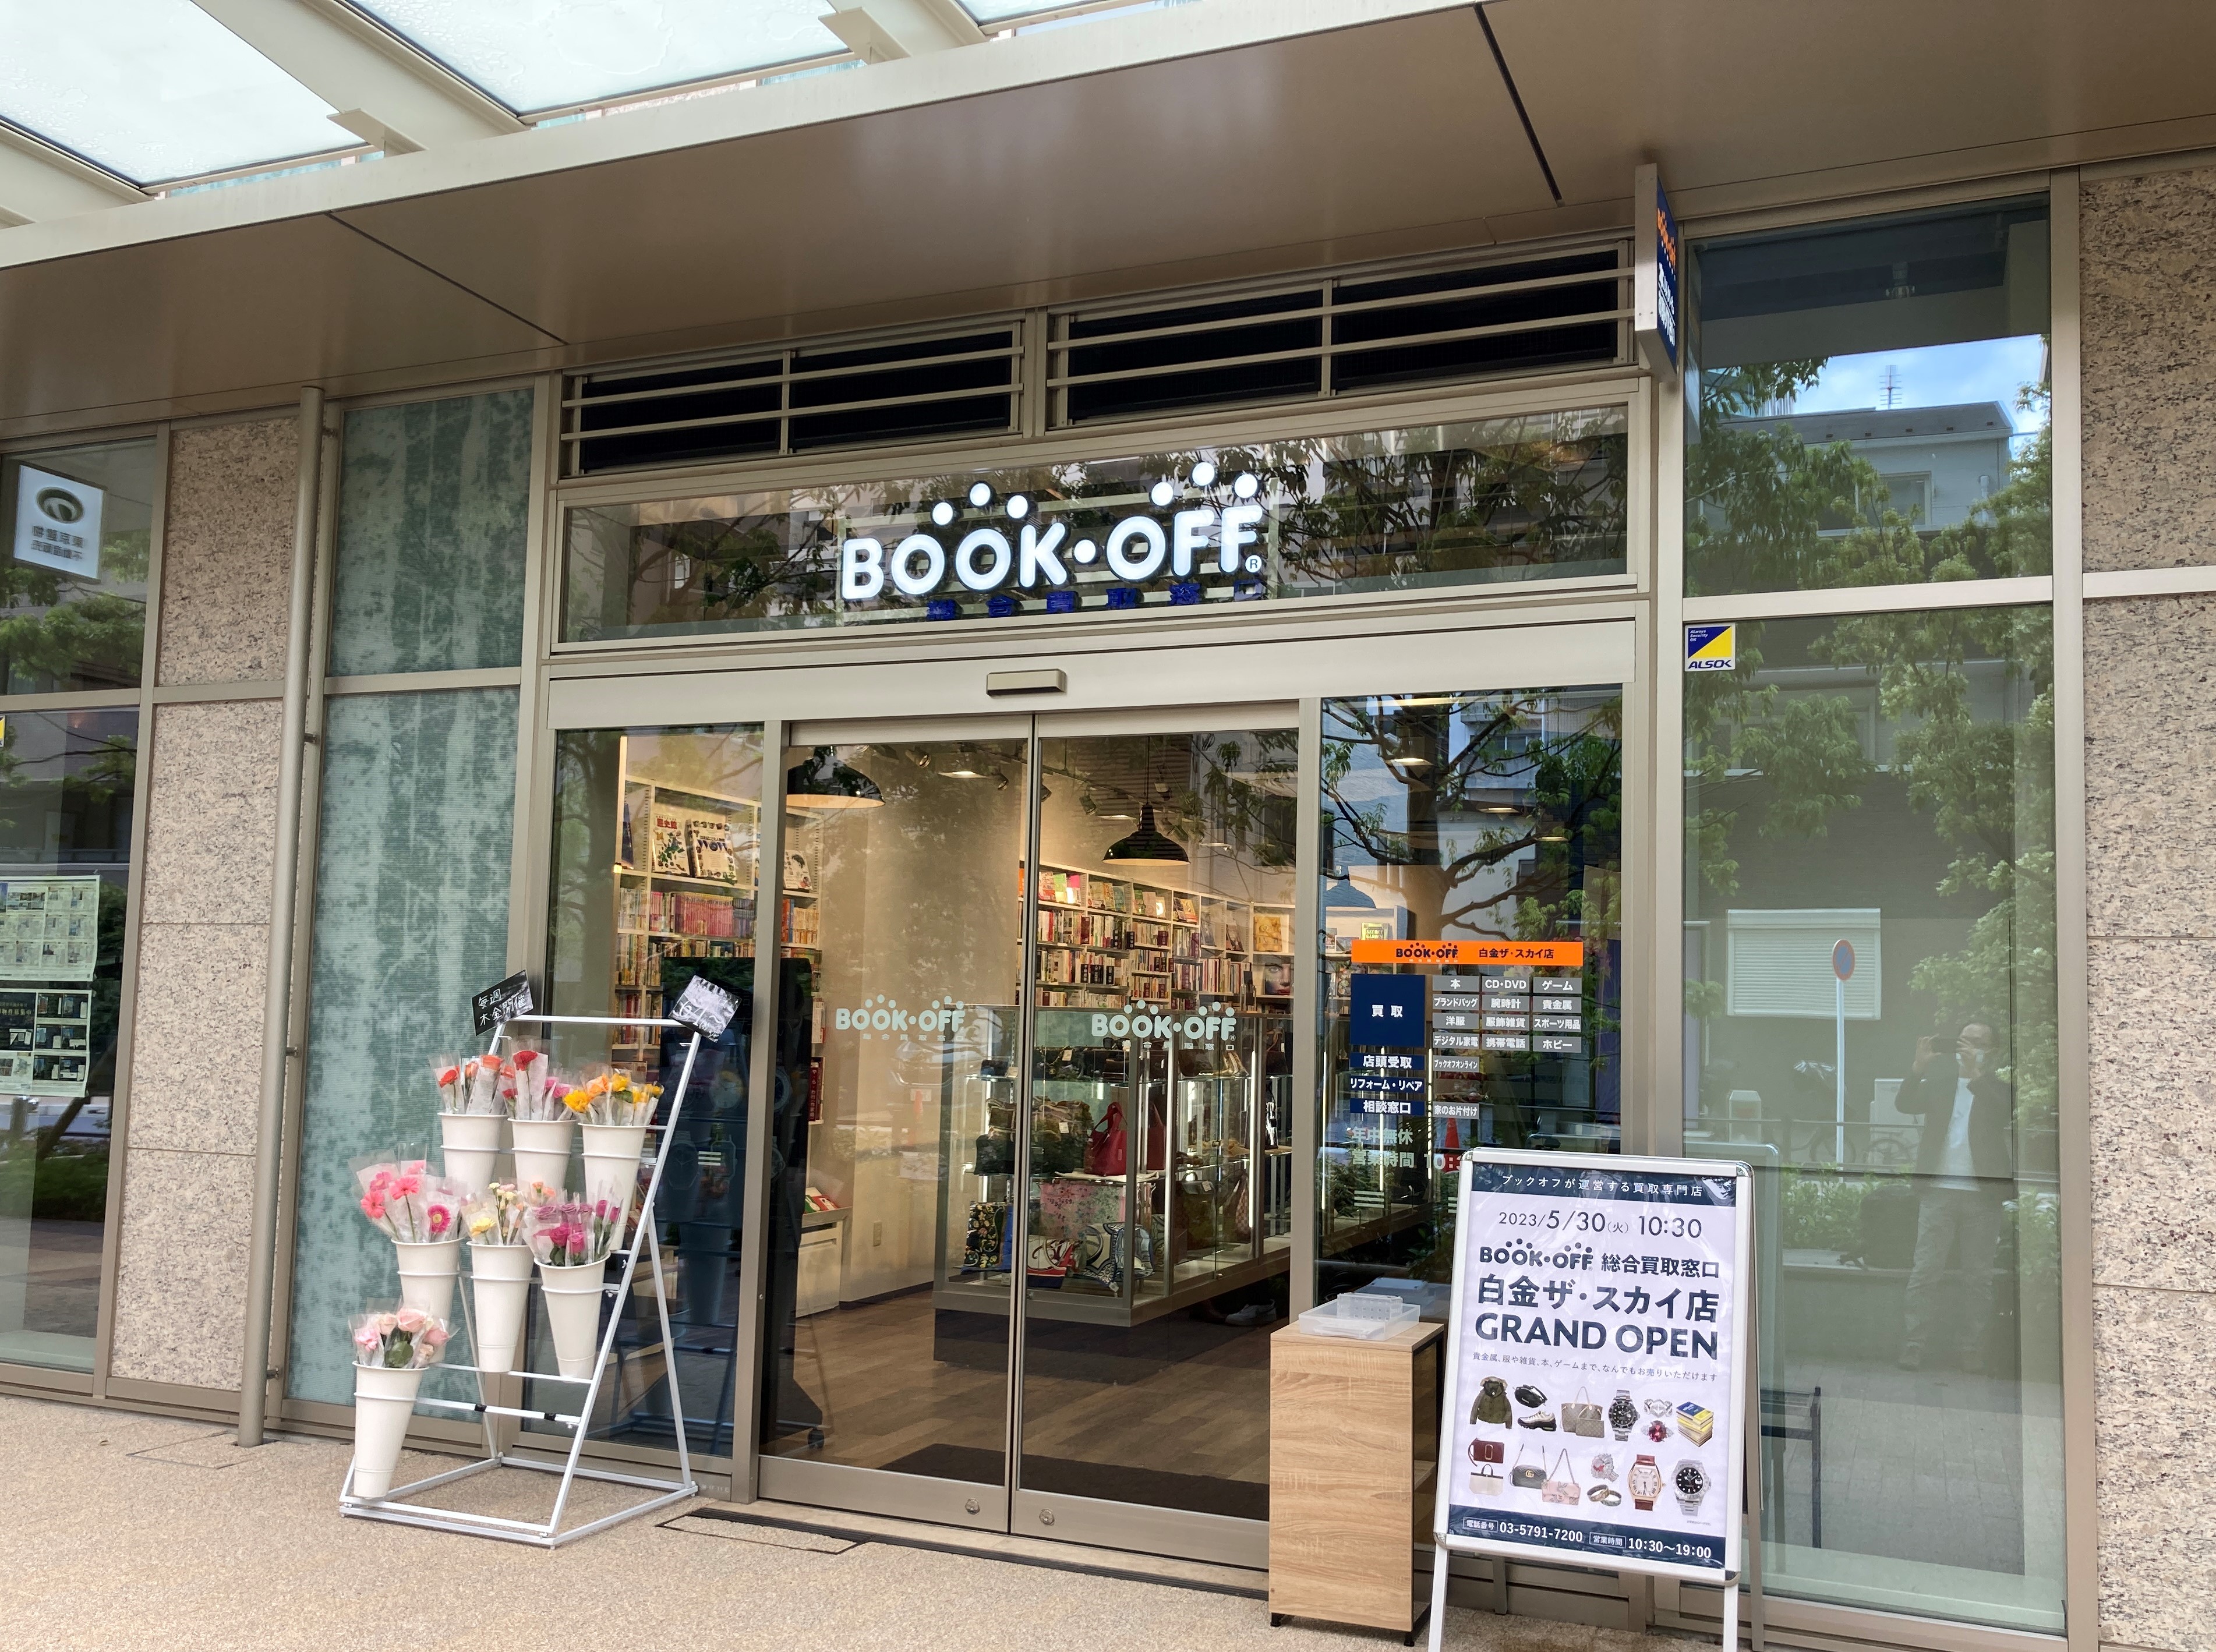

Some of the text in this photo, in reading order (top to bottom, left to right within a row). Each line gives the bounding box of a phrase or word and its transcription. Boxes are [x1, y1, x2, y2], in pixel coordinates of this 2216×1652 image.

[1688, 659, 1732, 669] ALSOK
[1479, 948, 1554, 959] 白金ザ・スカイ店
[1450, 979, 1461, 989] 本
[1542, 980, 1574, 991] ゲーム
[478, 988, 503, 1009] 毎週
[1433, 997, 1478, 1009] ブランドバッグ
[1490, 999, 1521, 1009] 腕時計
[1542, 1000, 1572, 1010] 貴金属
[1445, 1016, 1465, 1027] 洋服
[1486, 1017, 1525, 1028] 服飾雑貨
[1533, 1018, 1581, 1030] スポーツ用品
[1433, 1035, 1479, 1048] デジタル家電
[1486, 1037, 1526, 1049] 携帯電話
[1542, 1039, 1572, 1049] ホビー
[1362, 1055, 1412, 1069] 店頭受取
[1434, 1059, 1478, 1069] ブックオフオンライン
[1350, 1078, 1423, 1091] リフォーム・リペア
[1363, 1101, 1411, 1114] 相談窓口
[1434, 1105, 1478, 1117] 家のお片付け
[1351, 1126, 1413, 1145] 年中無休
[1352, 1148, 1461, 1171] 営業時間 10:
[1502, 1174, 1703, 1197] ブックオフが運営する買取専門店
[1638, 1215, 1702, 1239] 10:30
[1601, 1253, 1719, 1279] 総合買取窓口
[1478, 1274, 1720, 1323] 白金ザ・スカイ店
[1475, 1313, 1717, 1360] GRAND OPEN
[1466, 1518, 1495, 1531] 電話番号
[1500, 1521, 1583, 1543] 03-5791-7200
[1593, 1534, 1623, 1547] 営業時間
